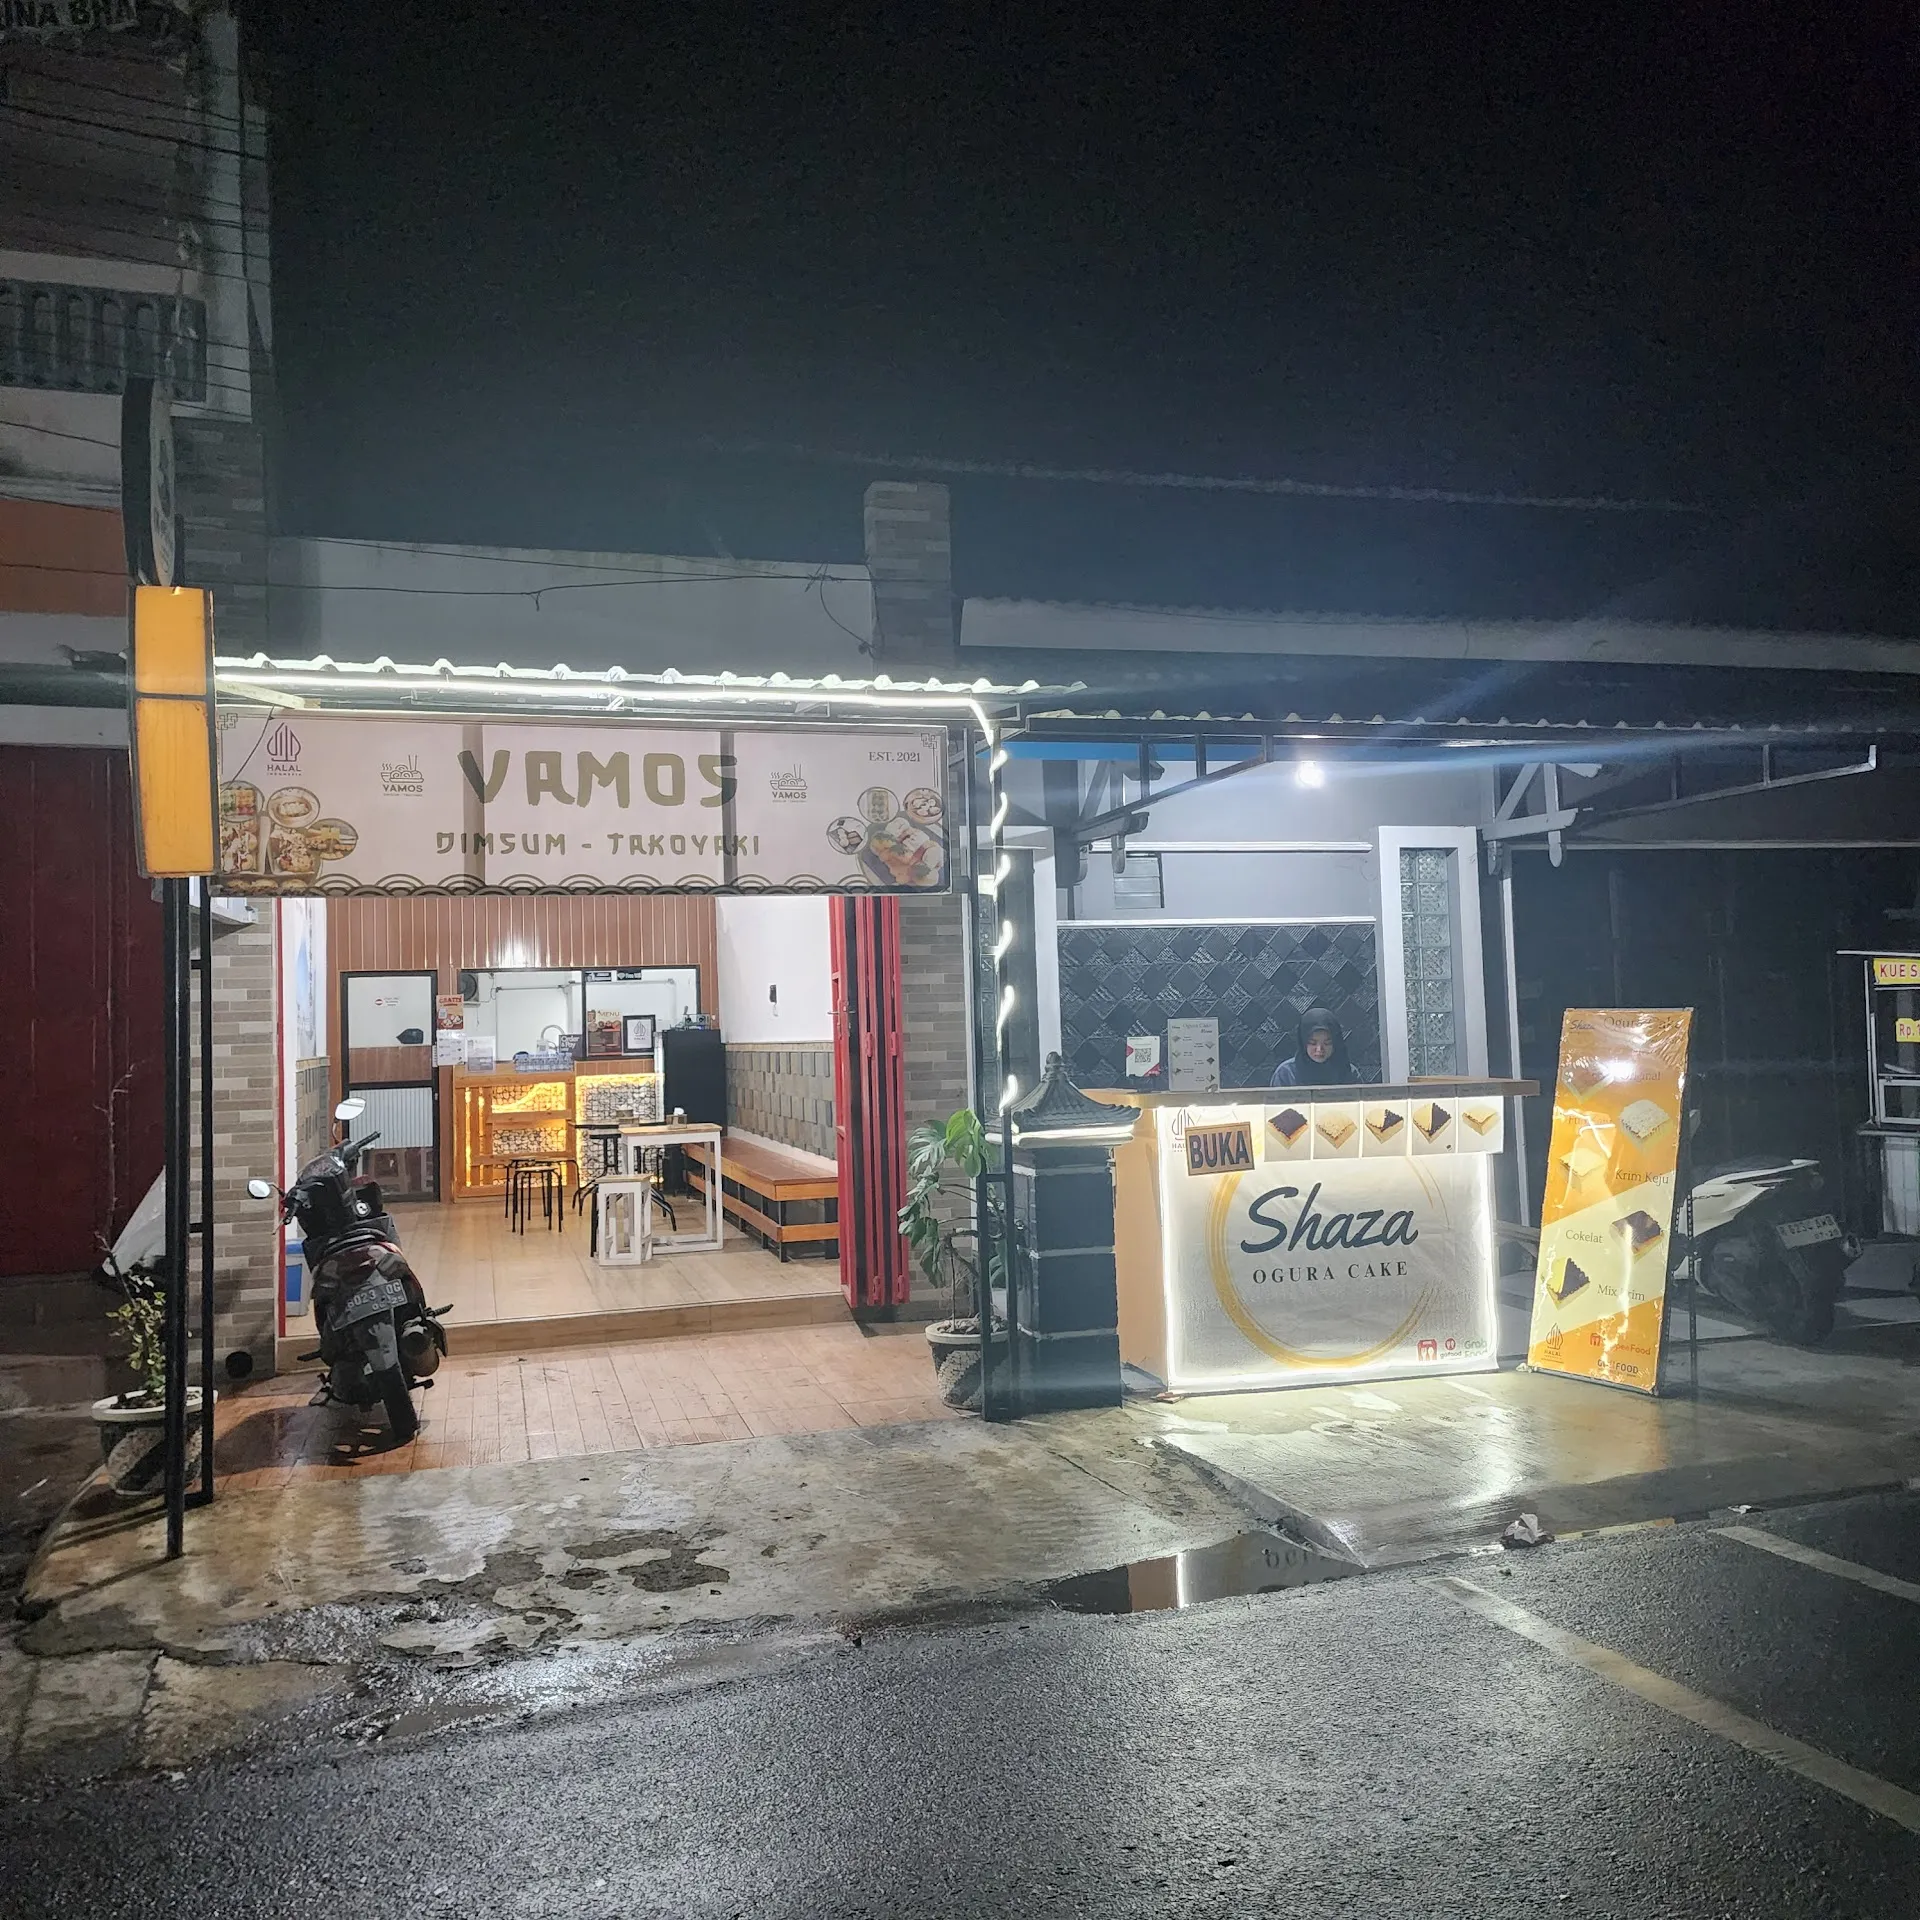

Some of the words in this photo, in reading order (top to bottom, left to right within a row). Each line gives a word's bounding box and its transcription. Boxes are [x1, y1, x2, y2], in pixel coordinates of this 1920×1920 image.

[868, 751, 894, 762] EST.
[896, 751, 921, 763] 2021
[267, 764, 302, 772] HALAL
[457, 749, 738, 809] VAMOS
[771, 791, 807, 799] VAMOS
[436, 831, 567, 855] DIMSUM
[606, 832, 760, 857] TAKOYAKI
[1880, 964, 1906, 978] KUE
[1188, 1130, 1251, 1169] BUKA
[1615, 1168, 1642, 1183] Krim
[1645, 1171, 1669, 1187] Keju
[1240, 1182, 1419, 1254] Shaza
[1565, 1229, 1604, 1244] Cokelat
[1252, 1265, 1335, 1284] OGURA
[1347, 1260, 1408, 1279] CAKE
[1597, 1284, 1617, 1297] Mix
[1620, 1286, 1645, 1301] rim
